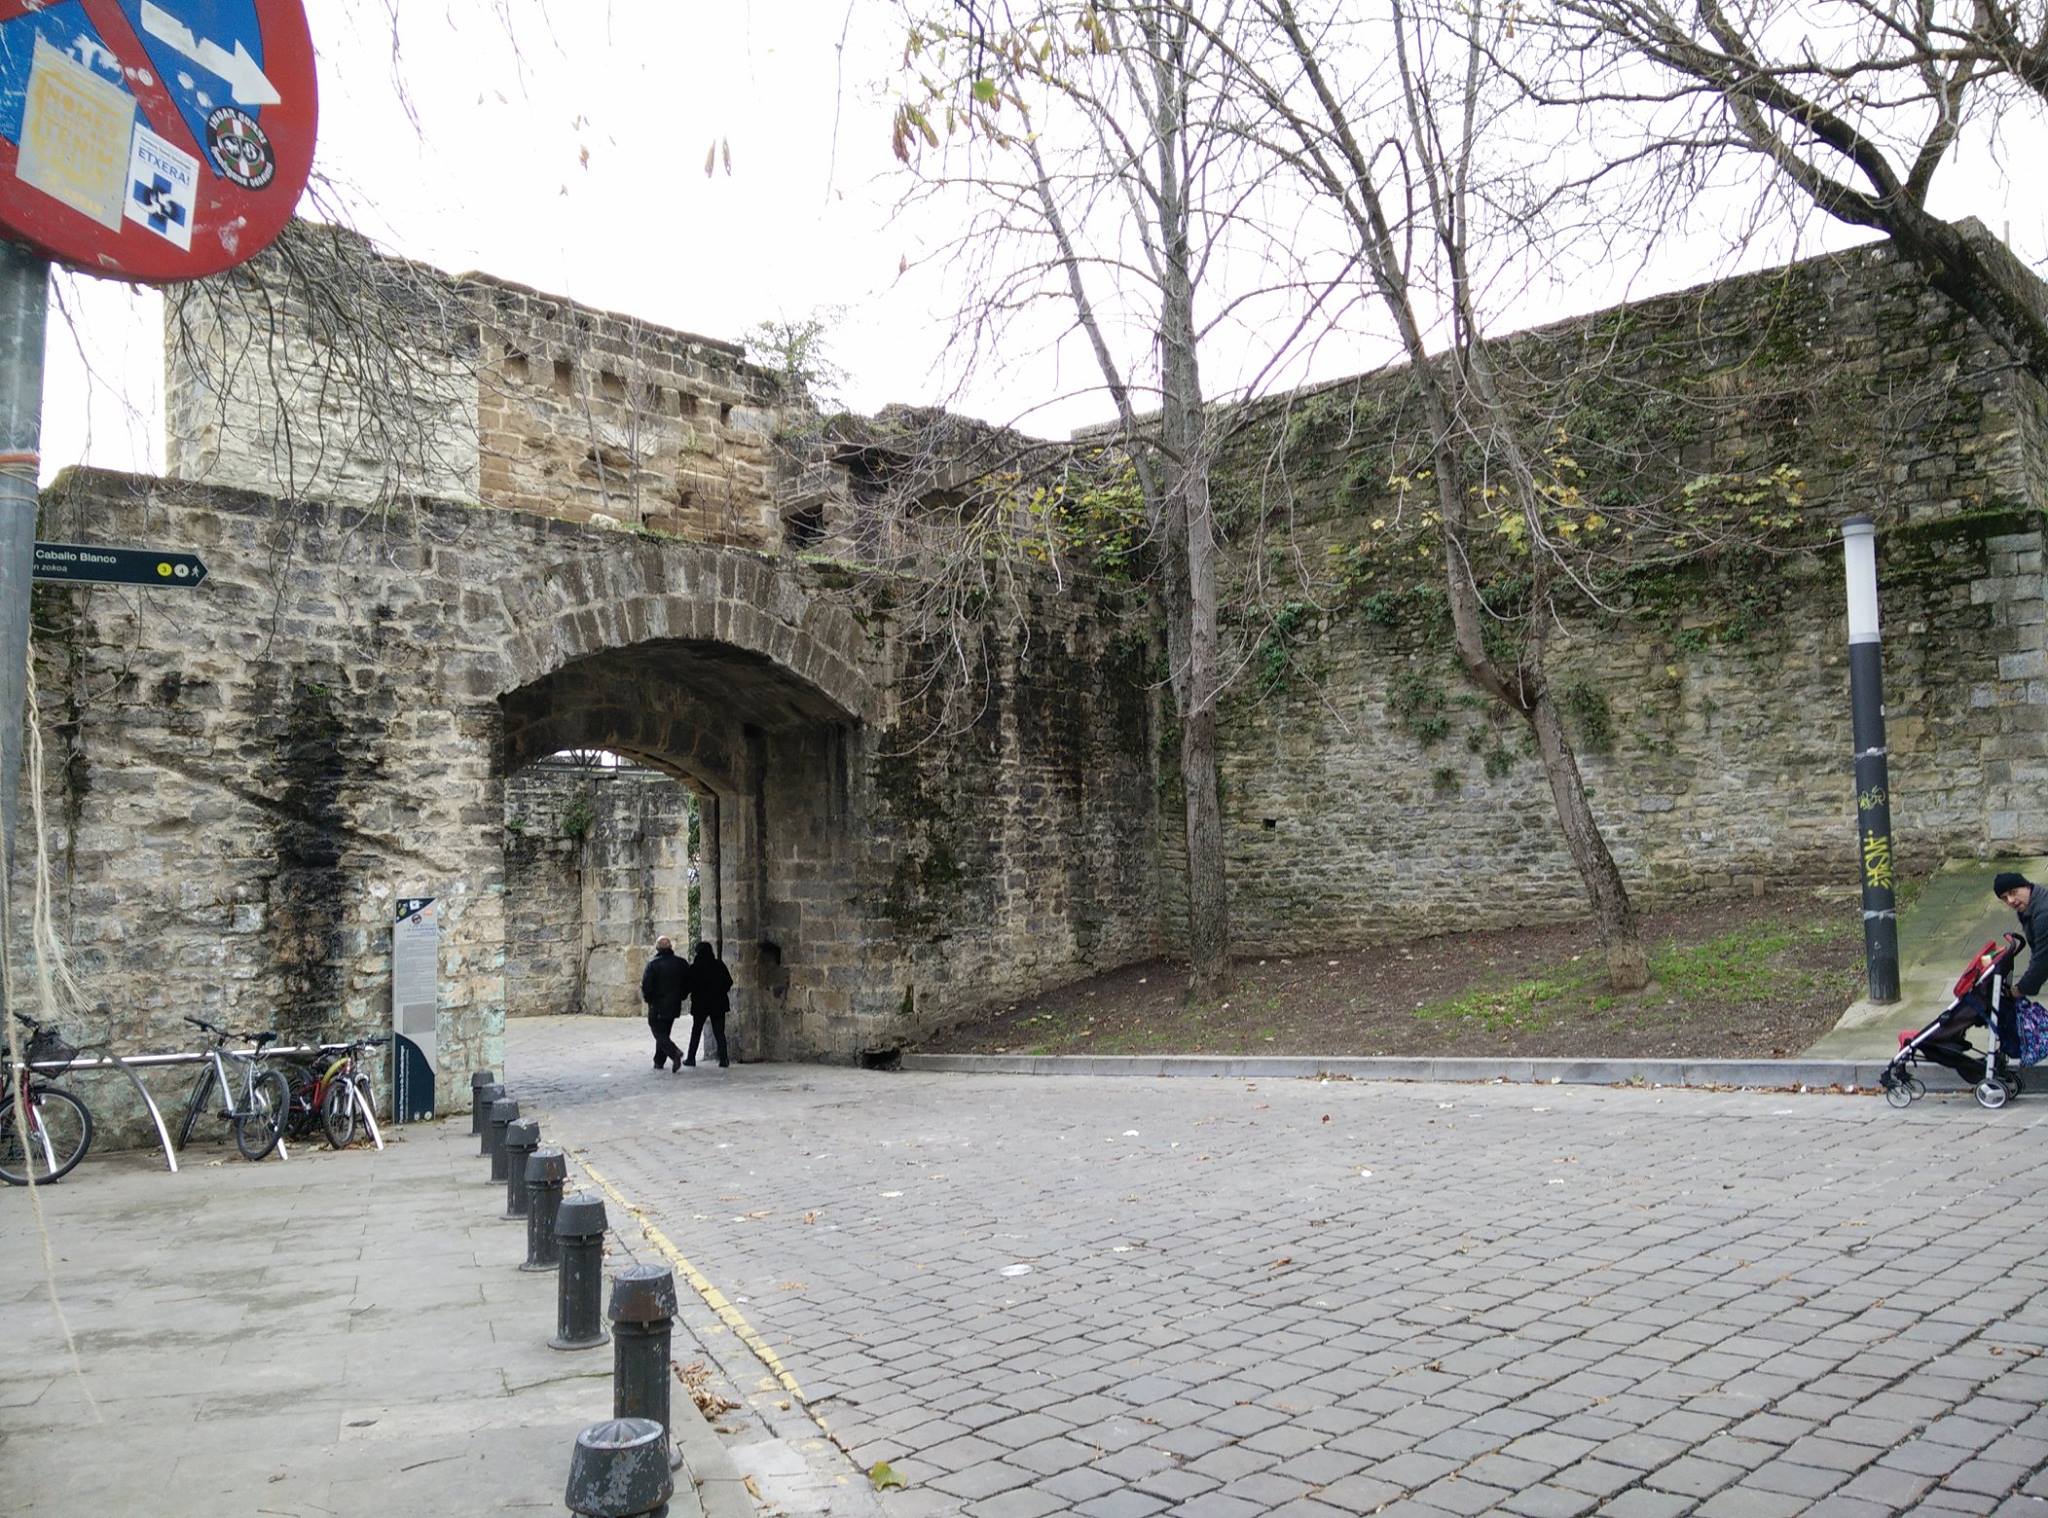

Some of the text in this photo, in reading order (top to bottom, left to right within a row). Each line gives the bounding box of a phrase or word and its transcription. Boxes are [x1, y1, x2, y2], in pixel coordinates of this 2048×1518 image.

[209, 108, 236, 130] INDAR
[138, 147, 190, 186] ETXERA!
[35, 549, 117, 564] Caballo Blanco
